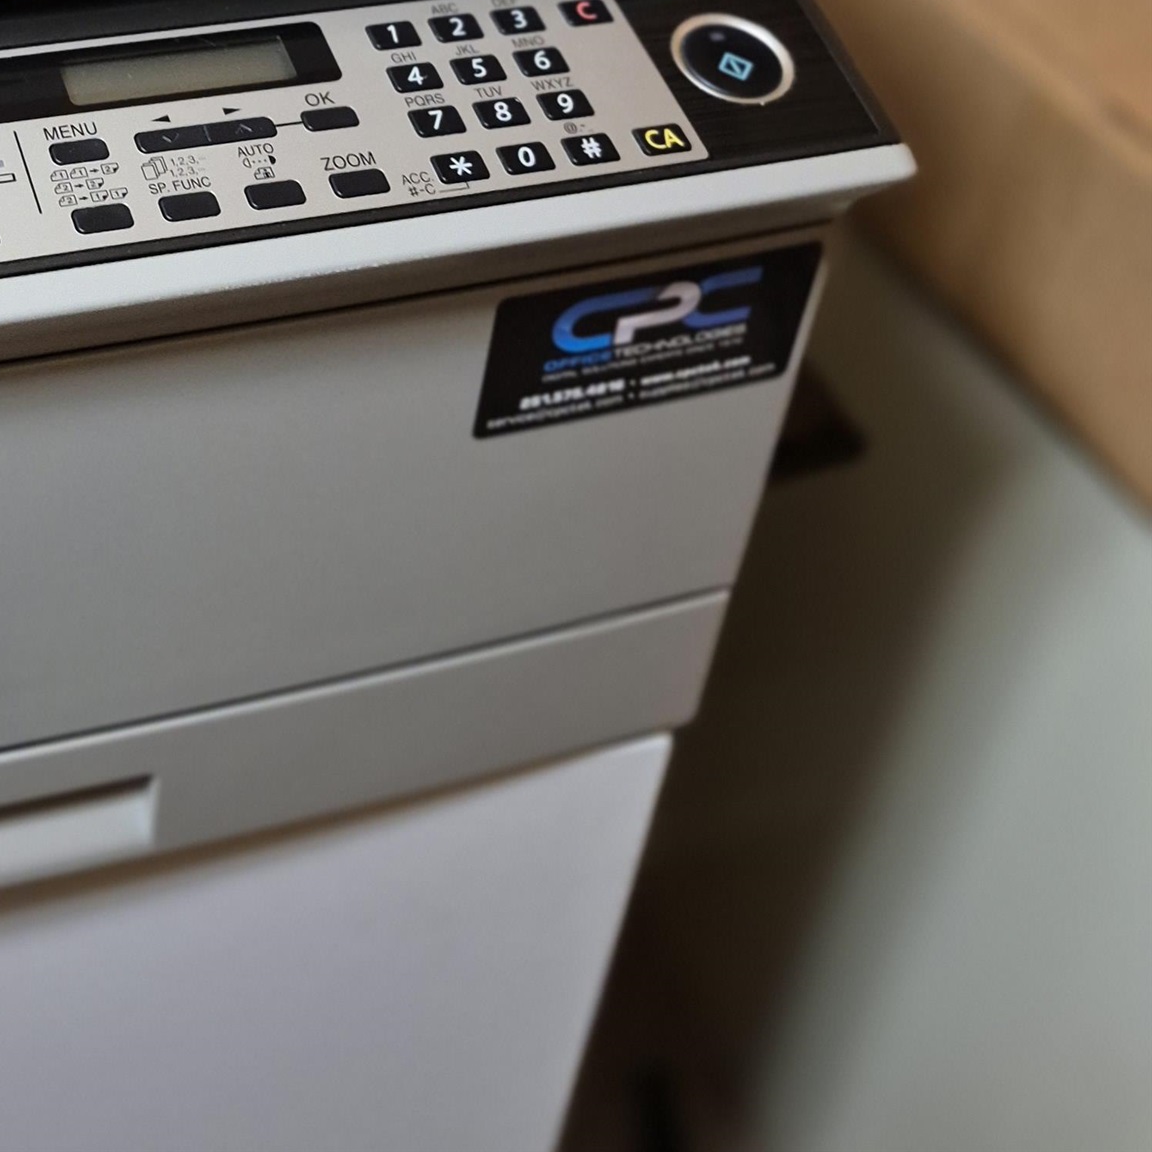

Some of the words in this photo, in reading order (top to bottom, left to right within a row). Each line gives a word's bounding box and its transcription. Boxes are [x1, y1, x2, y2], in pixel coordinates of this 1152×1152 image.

[431, 3, 460, 15] ABC
[576, 1, 598, 20] C
[449, 18, 466, 36] 2
[510, 10, 527, 29] 3
[387, 24, 399, 44] 1
[512, 35, 545, 49] MNO
[390, 51, 417, 65] GHI
[455, 46, 480, 57] JKL
[534, 50, 551, 70] 6
[407, 66, 424, 86] 4
[471, 57, 487, 78] 5
[475, 86, 503, 99] TUV
[530, 76, 574, 92] WXYZ
[304, 91, 335, 107] OK
[404, 93, 446, 108] PQRS
[556, 93, 574, 114] 9
[428, 109, 443, 130] 7
[493, 101, 512, 122] 8
[43, 122, 98, 141] MENU
[644, 128, 685, 150] CA
[238, 142, 274, 158] AUTO
[517, 146, 536, 168] 0
[580, 137, 602, 159] #
[320, 151, 377, 171] ZOOM
[148, 182, 170, 195] SP.
[171, 176, 212, 192] FUNC
[408, 183, 436, 197] #-C
[551, 266, 764, 353] CPC
